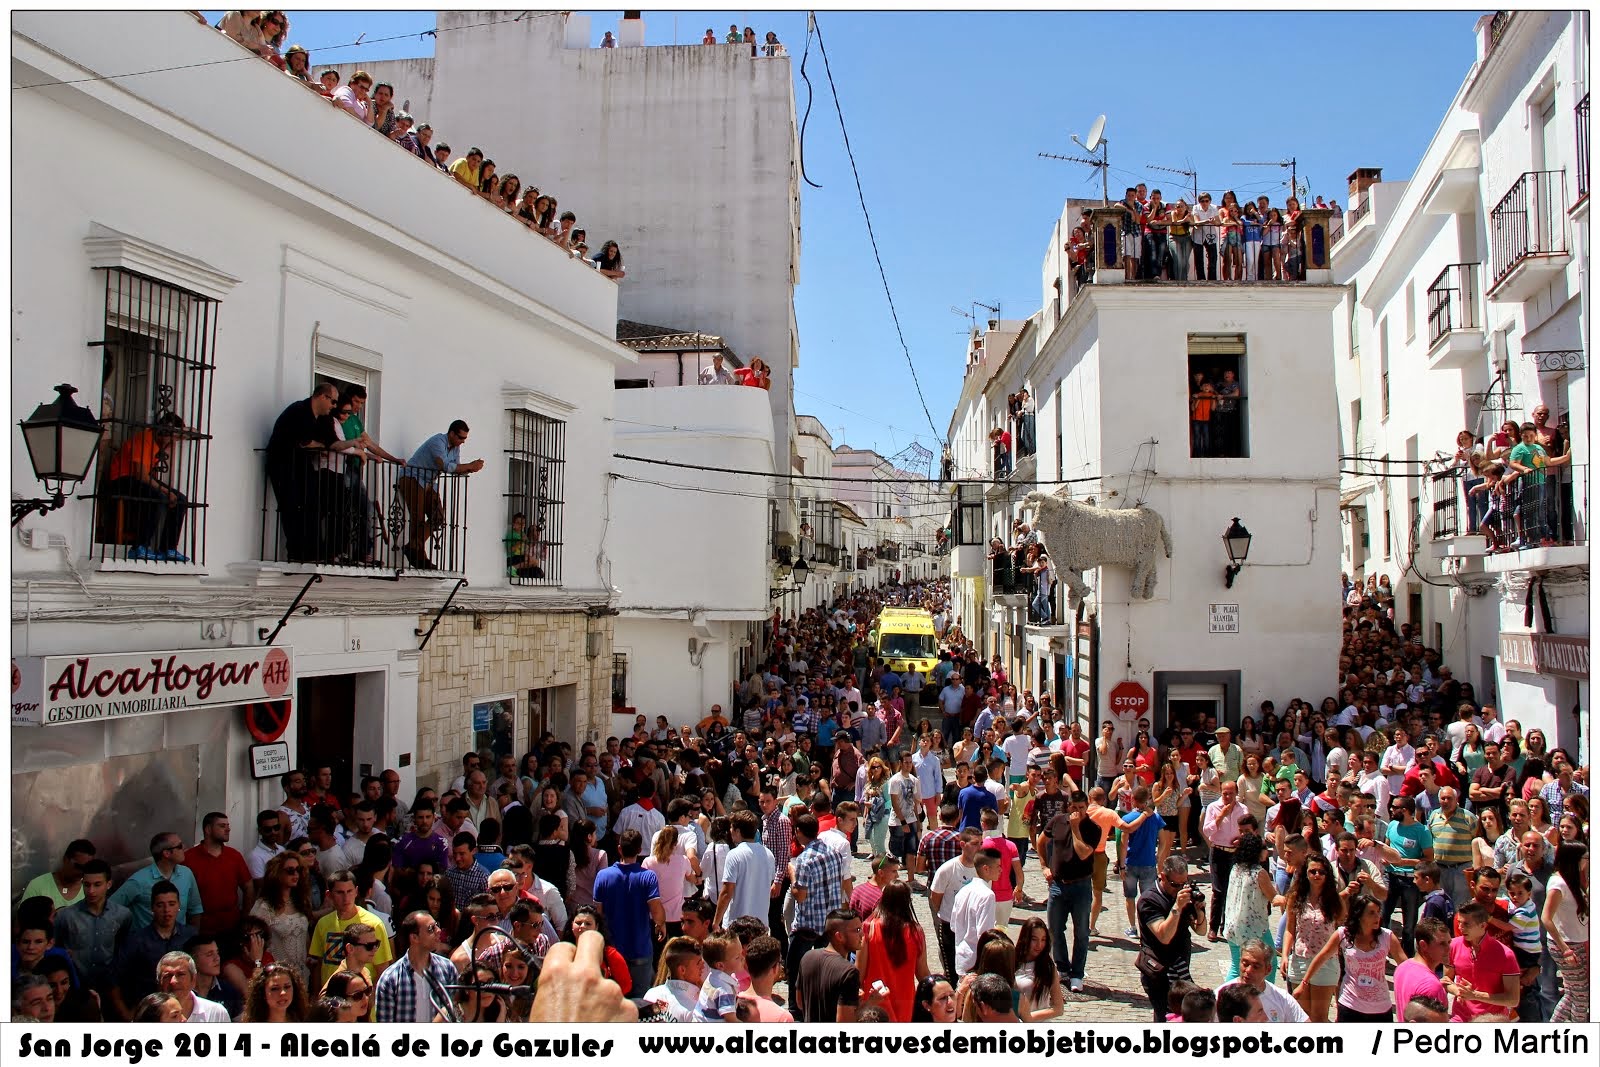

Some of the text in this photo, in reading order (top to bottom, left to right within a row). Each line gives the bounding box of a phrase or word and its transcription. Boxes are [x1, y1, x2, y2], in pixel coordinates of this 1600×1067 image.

[351, 638, 361, 651] 26
[1502, 640, 1520, 664] BAR
[1522, 641, 1539, 666] LOS
[48, 655, 260, 701] AlcaHogar
[263, 659, 289, 684] AH
[48, 695, 188, 722] GESTION INMOBILIARIA
[1114, 697, 1145, 706] STOP
